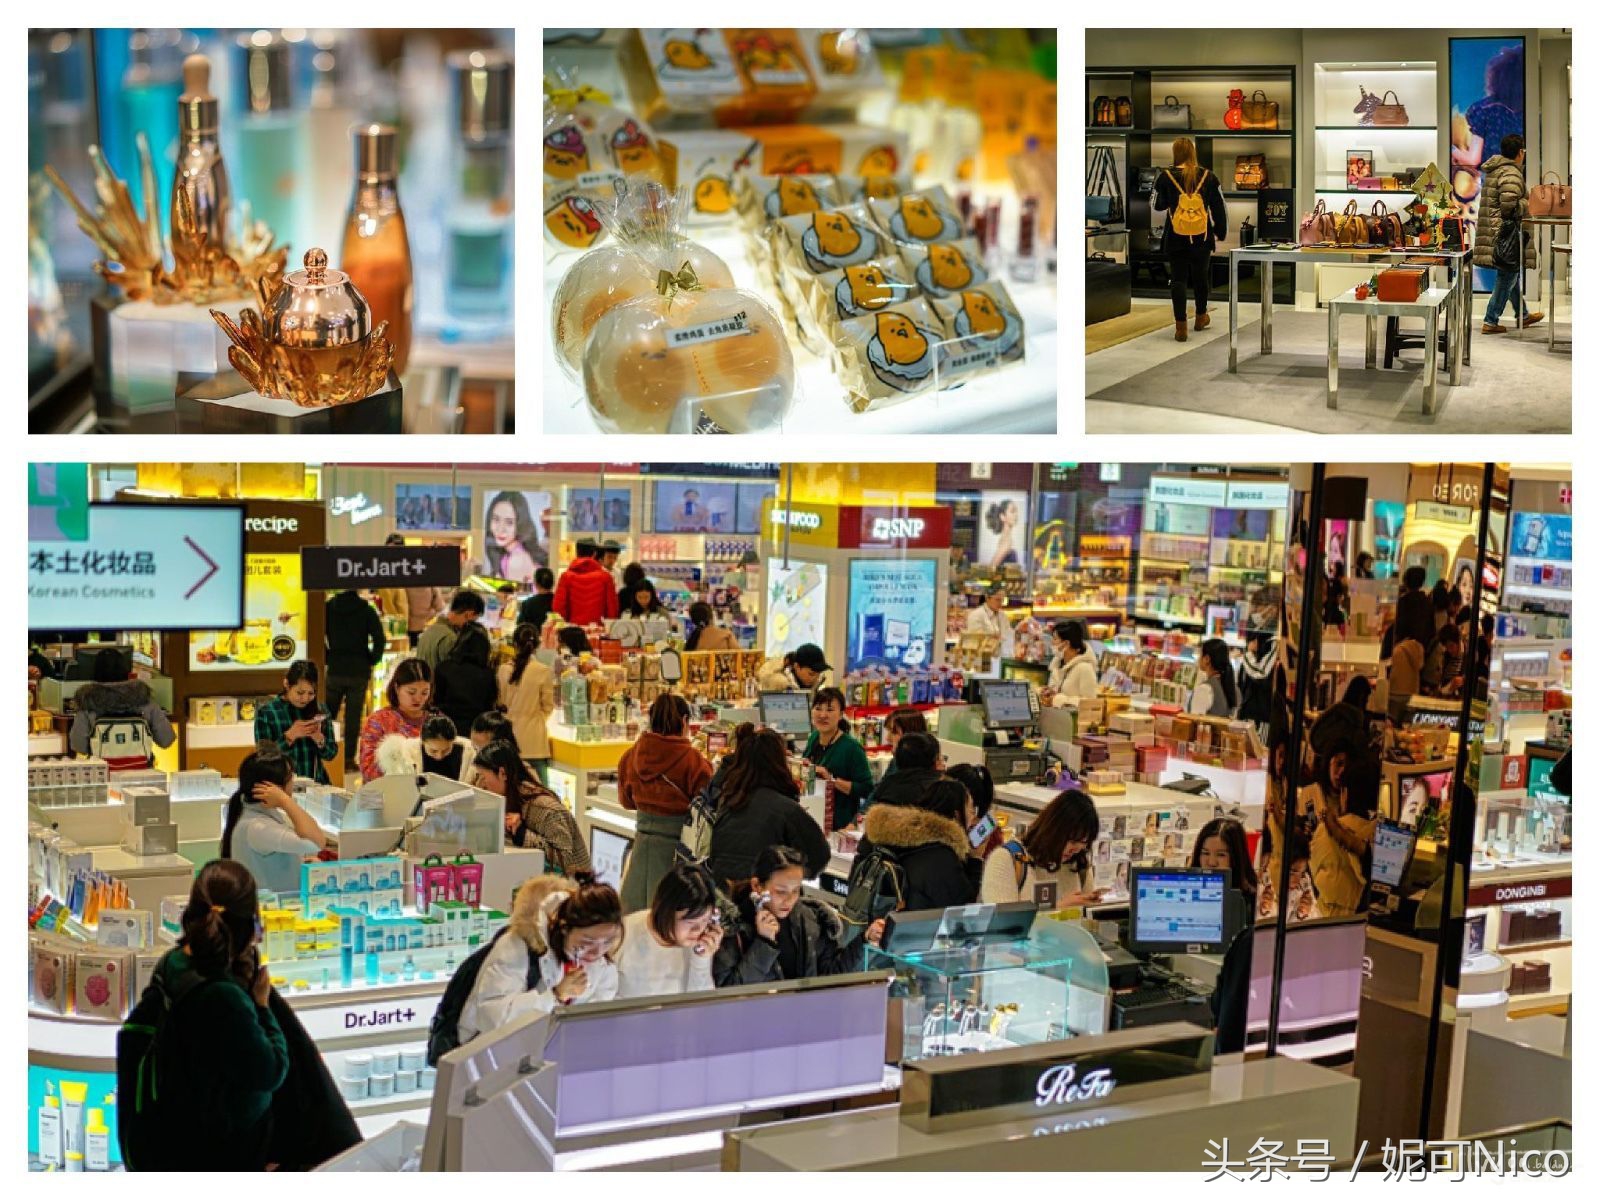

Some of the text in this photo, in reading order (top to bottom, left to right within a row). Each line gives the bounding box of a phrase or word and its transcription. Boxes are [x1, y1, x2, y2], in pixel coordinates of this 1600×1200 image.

[245, 515, 298, 535] recipe
[889, 517, 925, 538] SNP
[29, 548, 157, 576] 本土化妆品
[336, 557, 427, 578] Dr.Jart+
[81, 584, 156, 599] Cosmetics
[1495, 884, 1548, 901] DONGINBI
[345, 1007, 417, 1029] Dr.Jart+
[1034, 1062, 1117, 1107] ReFa
